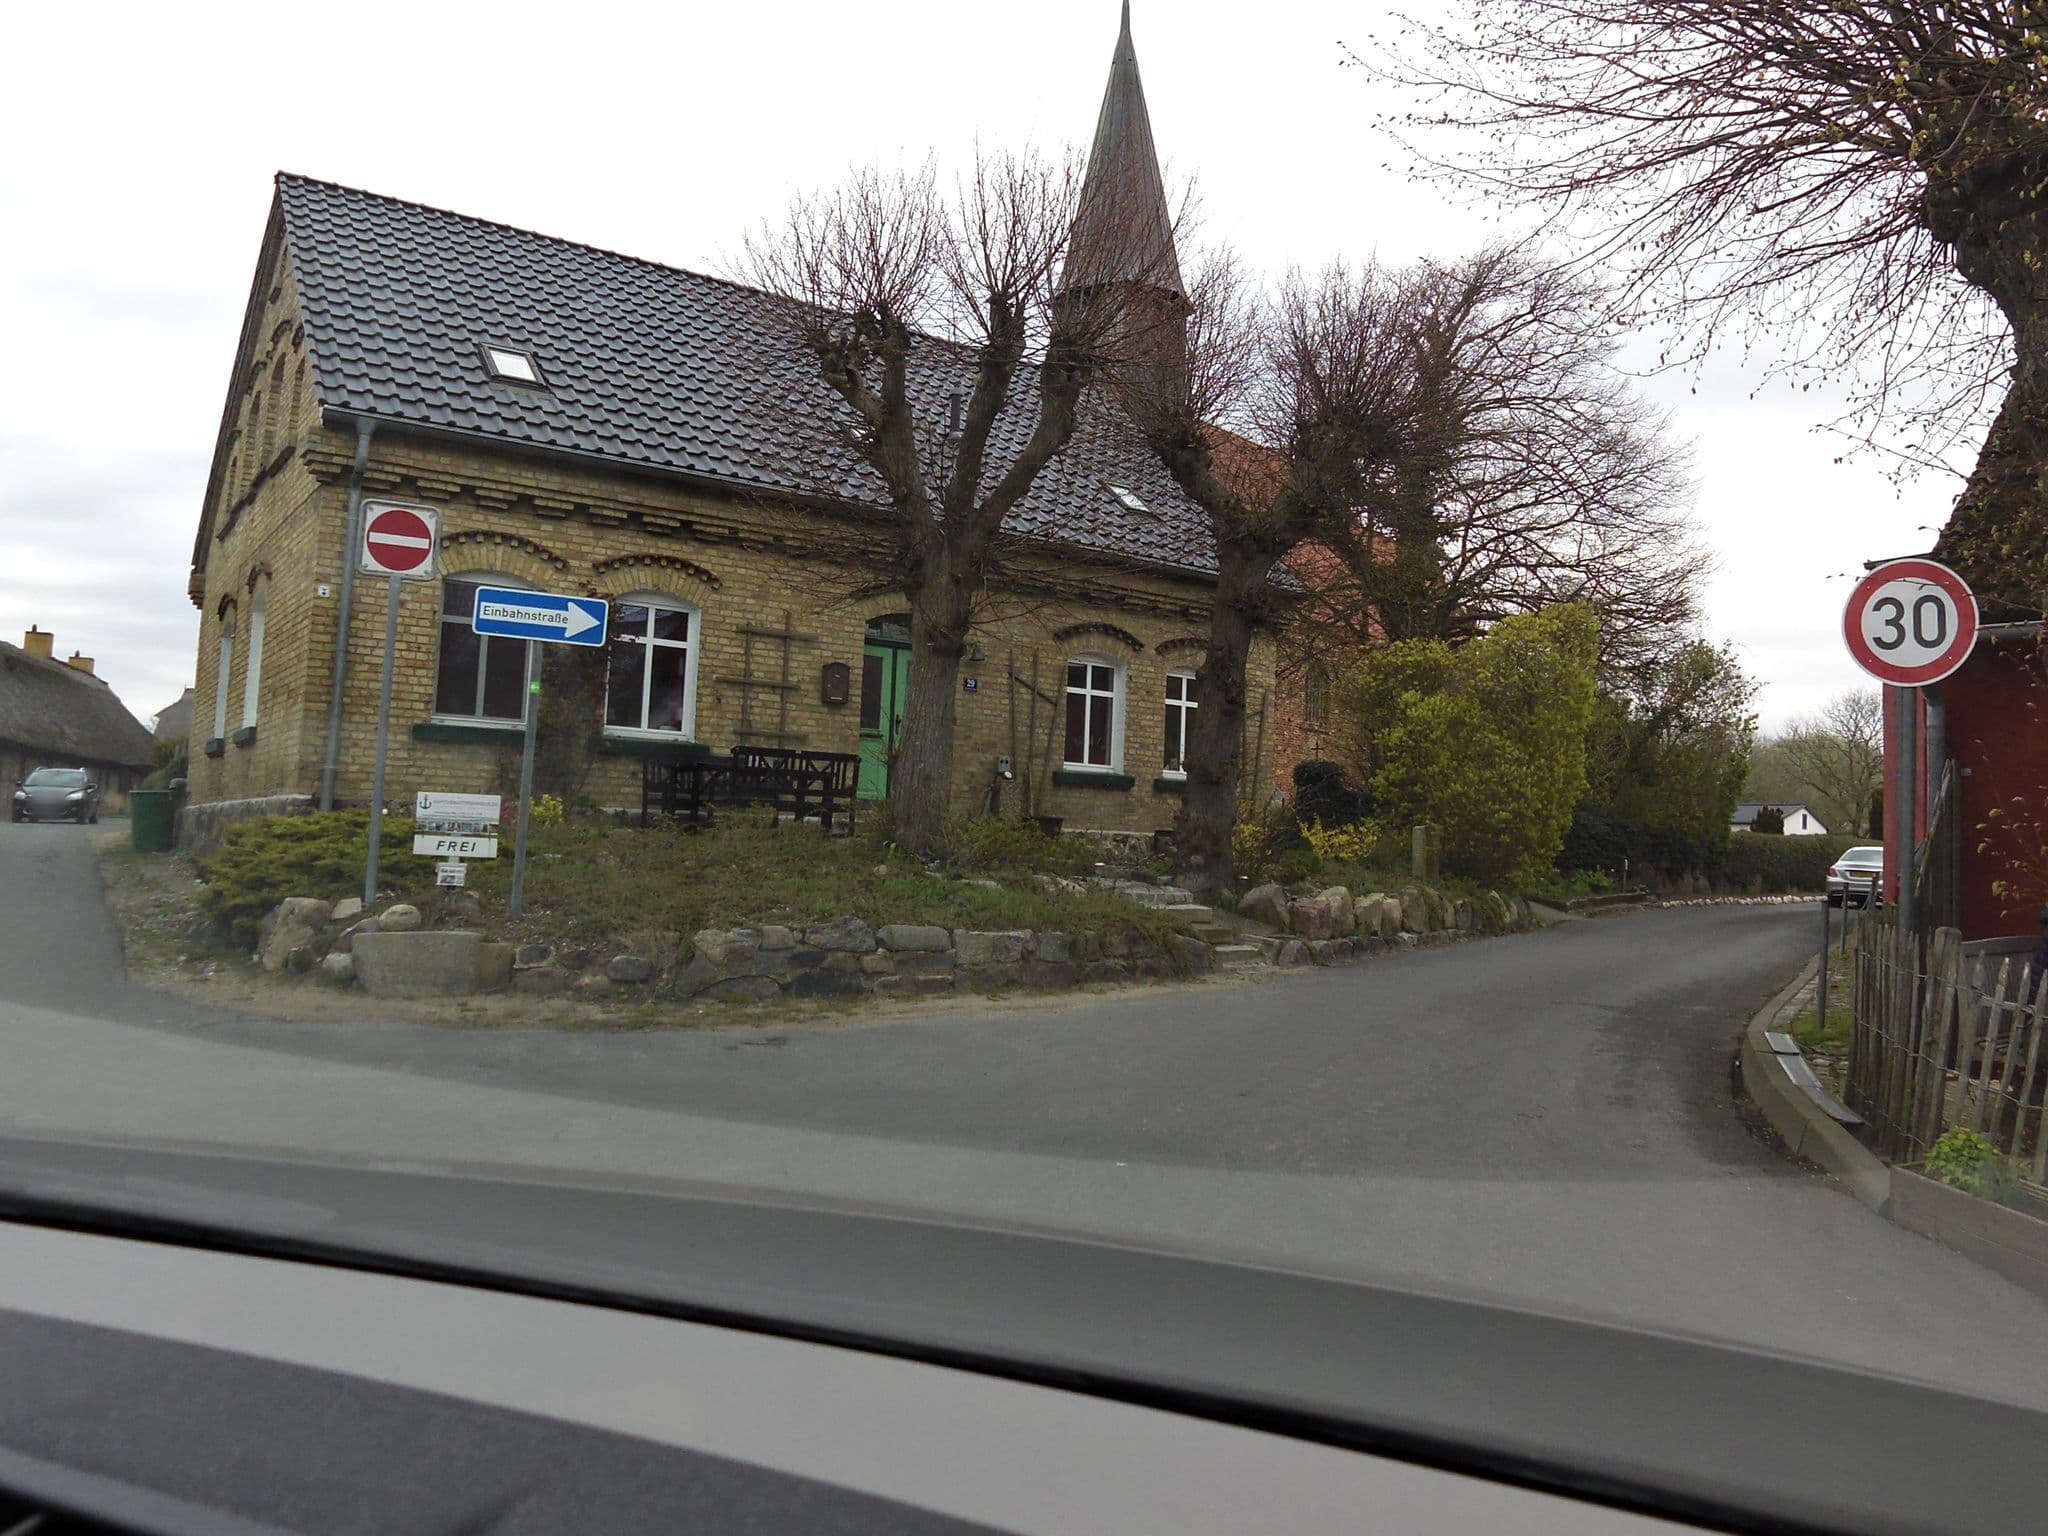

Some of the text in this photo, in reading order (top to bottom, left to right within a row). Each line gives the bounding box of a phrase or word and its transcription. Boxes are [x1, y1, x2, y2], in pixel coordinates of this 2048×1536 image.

[483, 605, 569, 624] Einbahnstraße
[1872, 594, 1947, 651] 30
[436, 840, 476, 852] FREI
